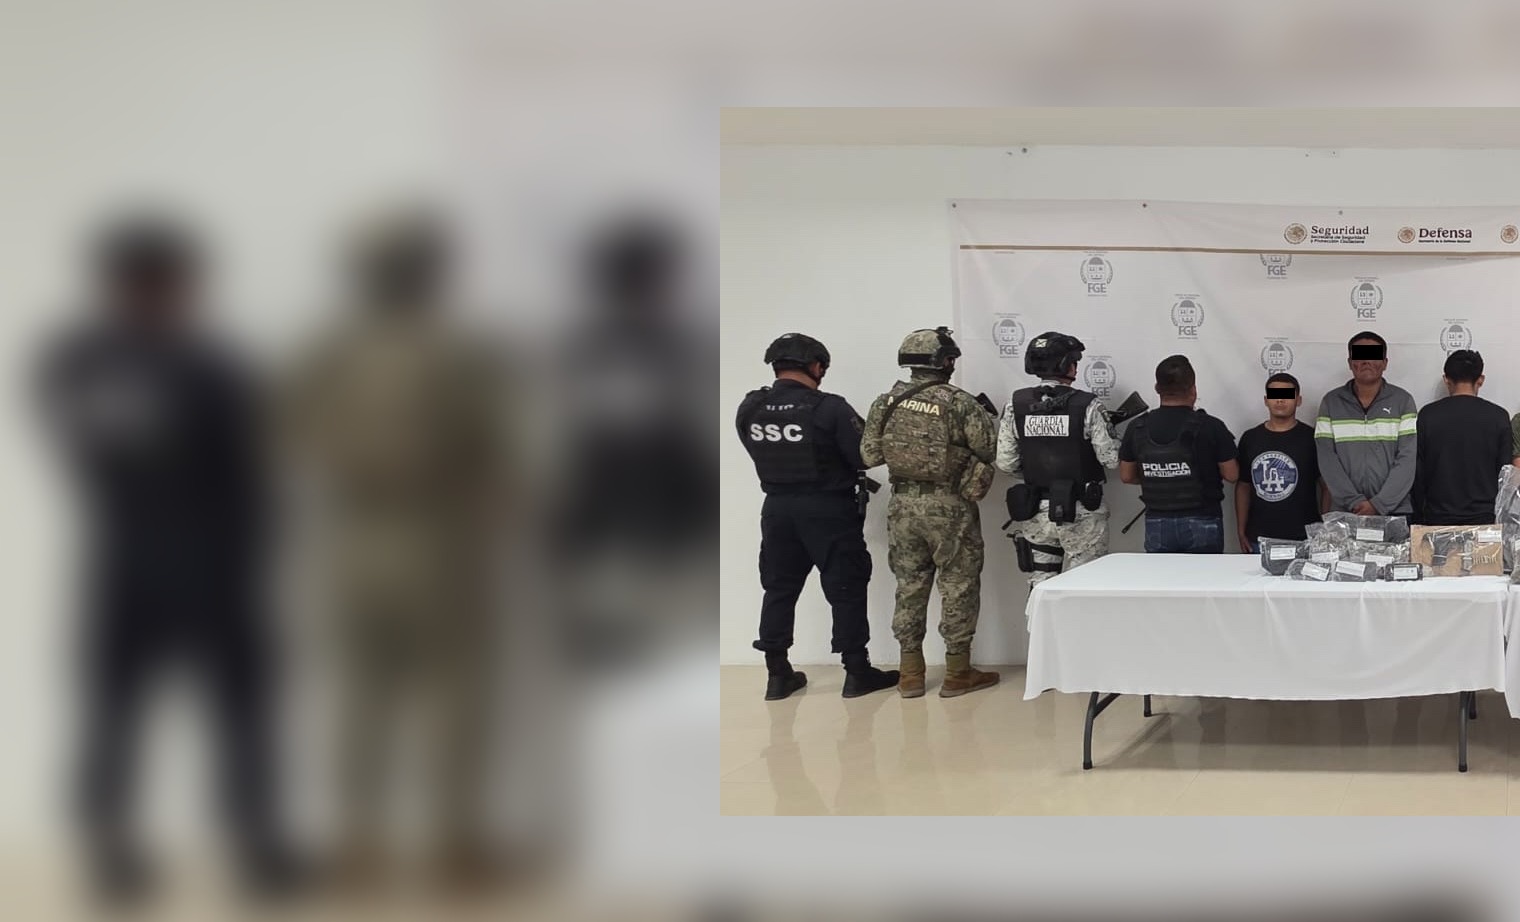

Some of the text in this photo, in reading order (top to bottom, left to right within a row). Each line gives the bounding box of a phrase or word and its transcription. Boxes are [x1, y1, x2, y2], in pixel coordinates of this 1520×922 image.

[1311, 225, 1369, 236] Seguridad
[1419, 228, 1472, 238] Defensa
[1266, 264, 1287, 276] FGE
[1087, 282, 1107, 293] FGE
[1356, 307, 1377, 319] FGE
[1178, 324, 1198, 336] FGE
[999, 344, 1019, 355] FGE
[1029, 416, 1064, 427] GUARDIA
[750, 423, 804, 442] SSC
[1026, 425, 1067, 436] NACIONAL
[1142, 462, 1190, 471] POLICIA
[1262, 460, 1284, 491] LA
